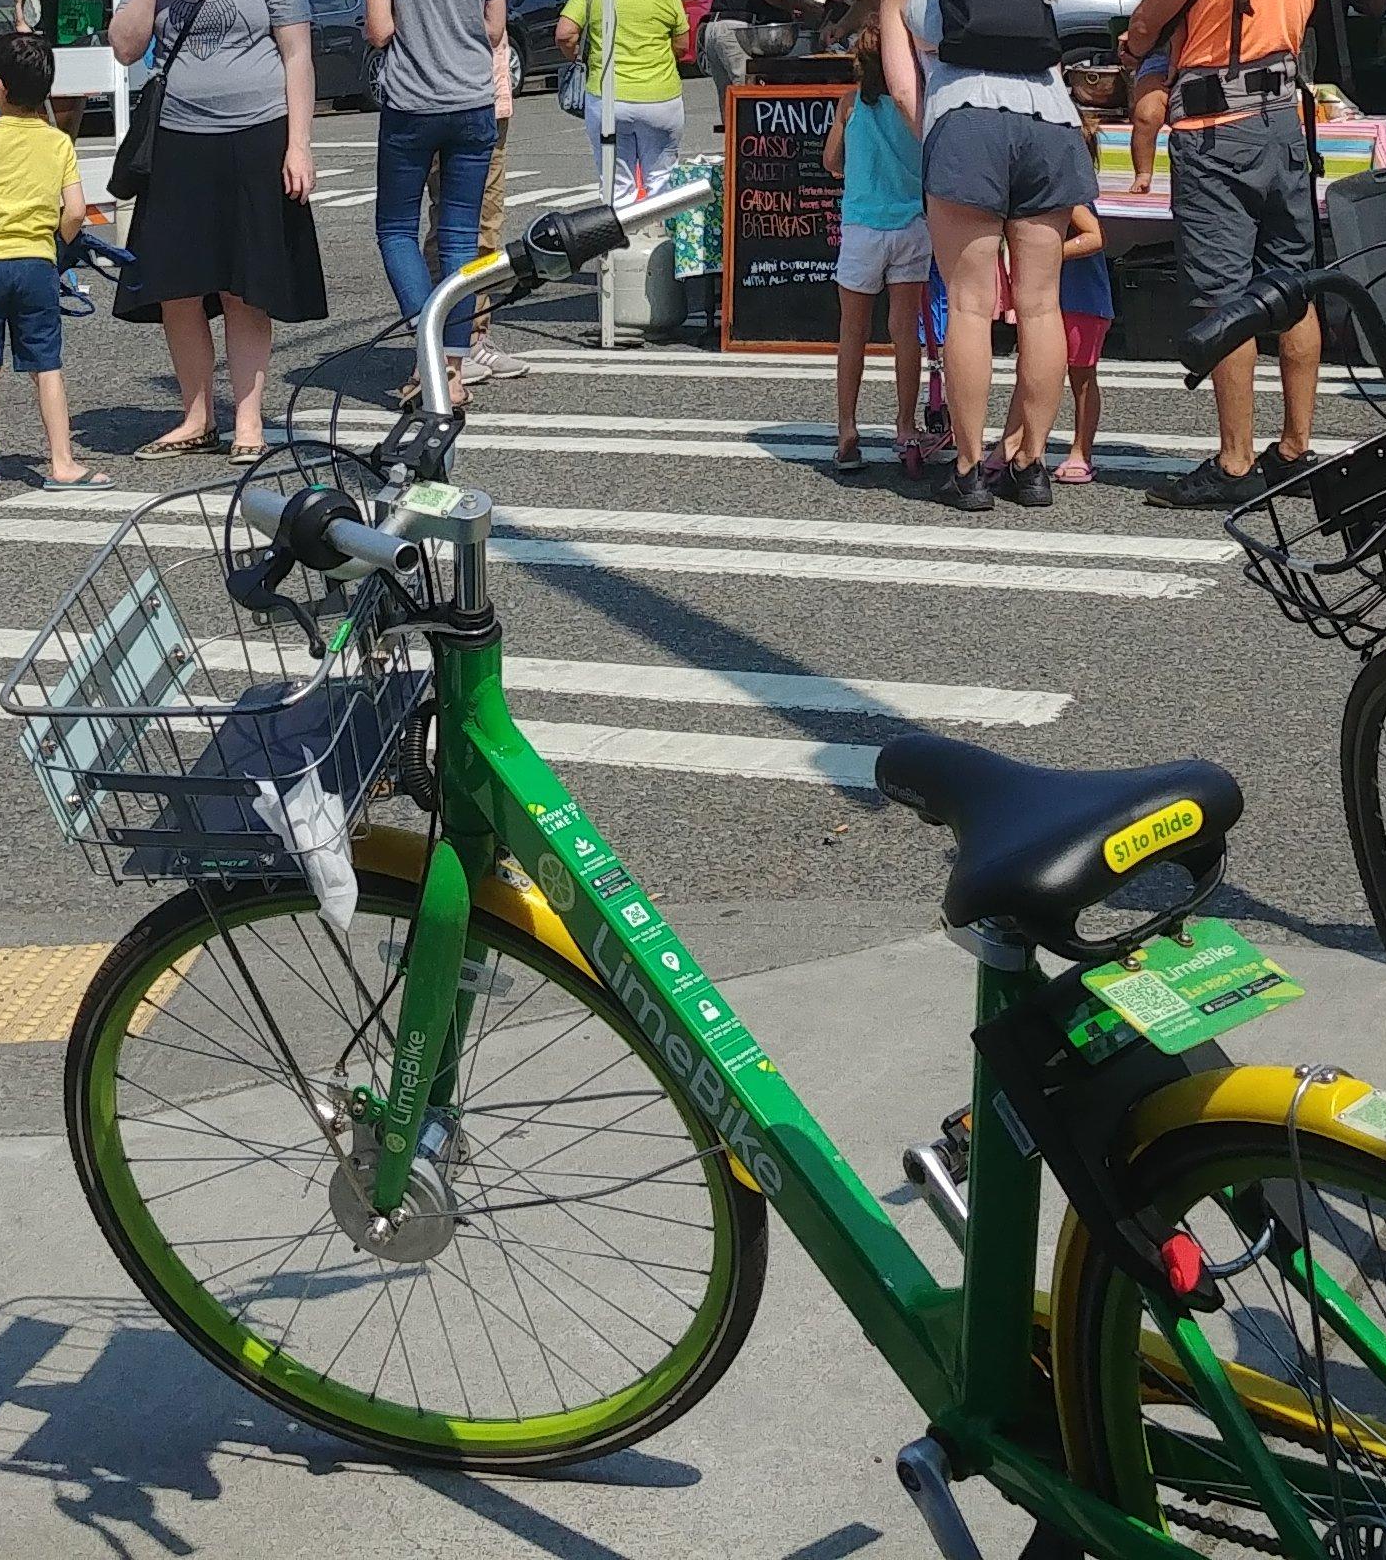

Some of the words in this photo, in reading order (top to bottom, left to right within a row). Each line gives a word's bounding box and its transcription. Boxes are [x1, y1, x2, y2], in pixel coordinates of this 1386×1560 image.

[793, 273, 806, 282] OF
[808, 273, 828, 282] THE
[536, 809, 564, 828] How
[563, 801, 578, 815] to
[543, 815, 573, 836] LIME
[1113, 840, 1131, 864] $1
[1131, 833, 1150, 852] to
[1151, 811, 1194, 842] Ride
[1162, 943, 1238, 982] LimeBike
[390, 1029, 427, 1126] LimeBike
[592, 921, 783, 1197] LimeBike
